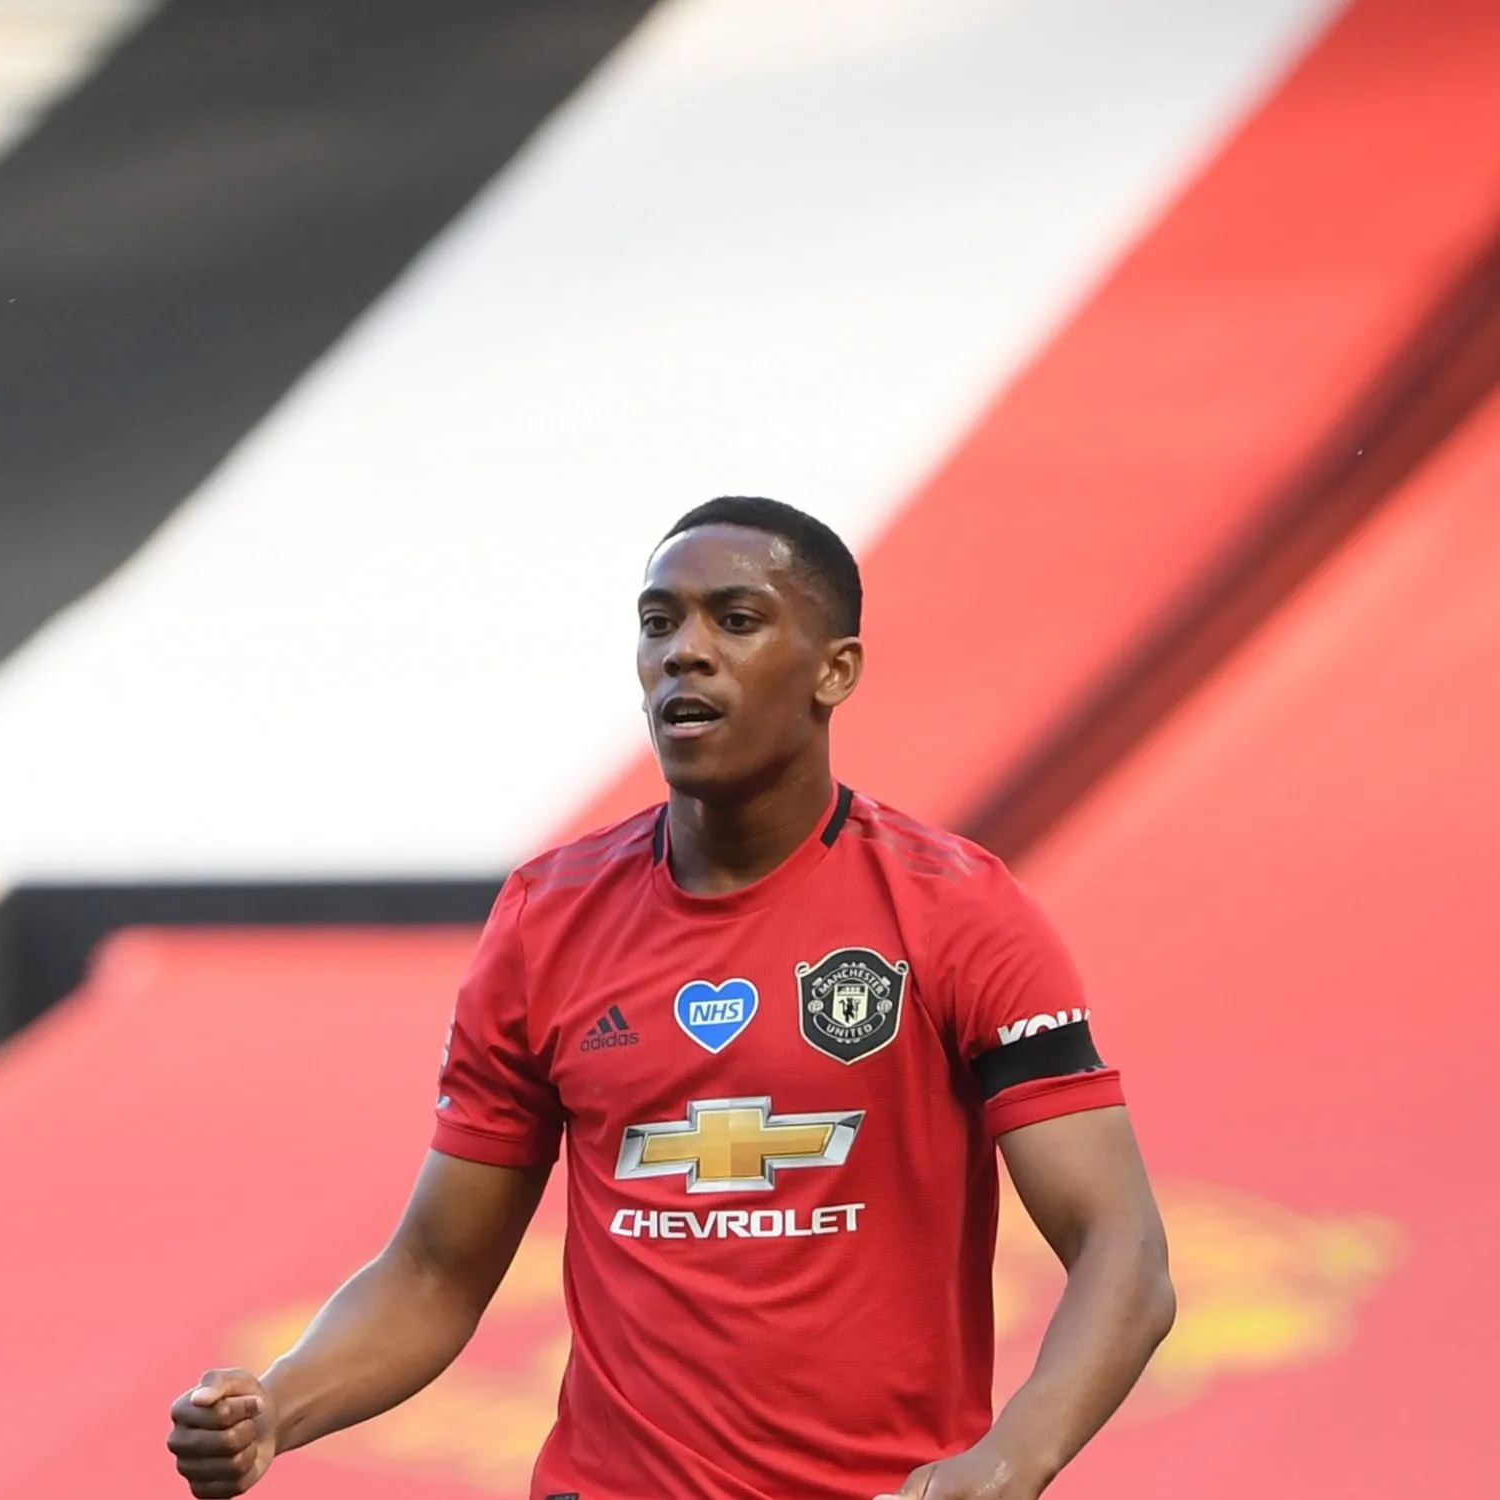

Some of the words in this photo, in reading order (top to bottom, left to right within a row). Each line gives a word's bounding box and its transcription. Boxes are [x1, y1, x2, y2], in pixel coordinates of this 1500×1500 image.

[818, 968, 884, 994] MANCHESTER
[692, 1001, 741, 1023] NHS
[580, 1031, 640, 1052] adidas
[826, 1023, 874, 1038] UNITED
[609, 1203, 866, 1239] CHEVROLET
